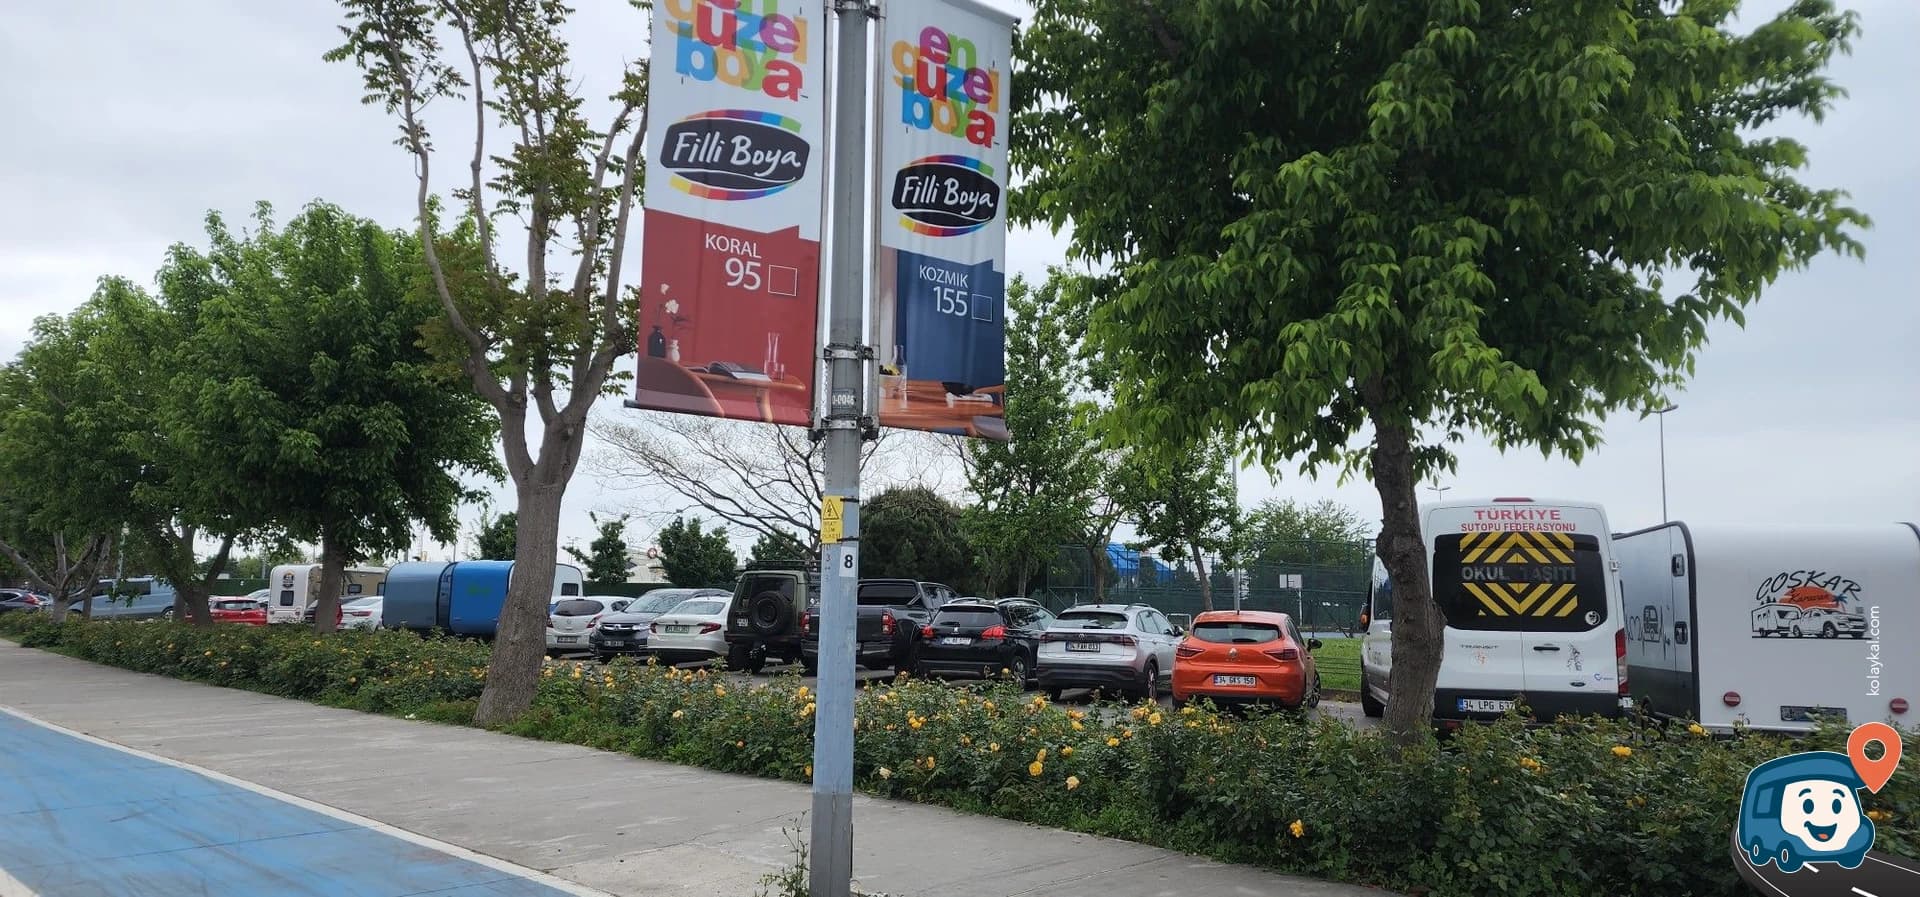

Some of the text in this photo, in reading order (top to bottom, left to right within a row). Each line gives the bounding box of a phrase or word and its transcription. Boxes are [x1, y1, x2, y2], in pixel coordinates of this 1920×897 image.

[676, 21, 803, 102] boya
[920, 26, 977, 69] en
[902, 76, 995, 149] boya
[672, 131, 801, 177] Filli Boya
[901, 174, 994, 215] Filli Boya
[705, 232, 762, 259] KORAL
[725, 257, 761, 290] 95
[919, 264, 968, 289] KOZMIK
[933, 286, 968, 317] 155
[1461, 522, 1576, 532] SUTOPU FEDERASYONU
[1473, 507, 1561, 521] TÜRKİYE
[844, 554, 853, 569] 8
[1461, 566, 1510, 580] OKUL
[1756, 570, 1862, 601] COSKAR
[1463, 700, 1473, 710] 34
[1479, 700, 1495, 711] LPG
